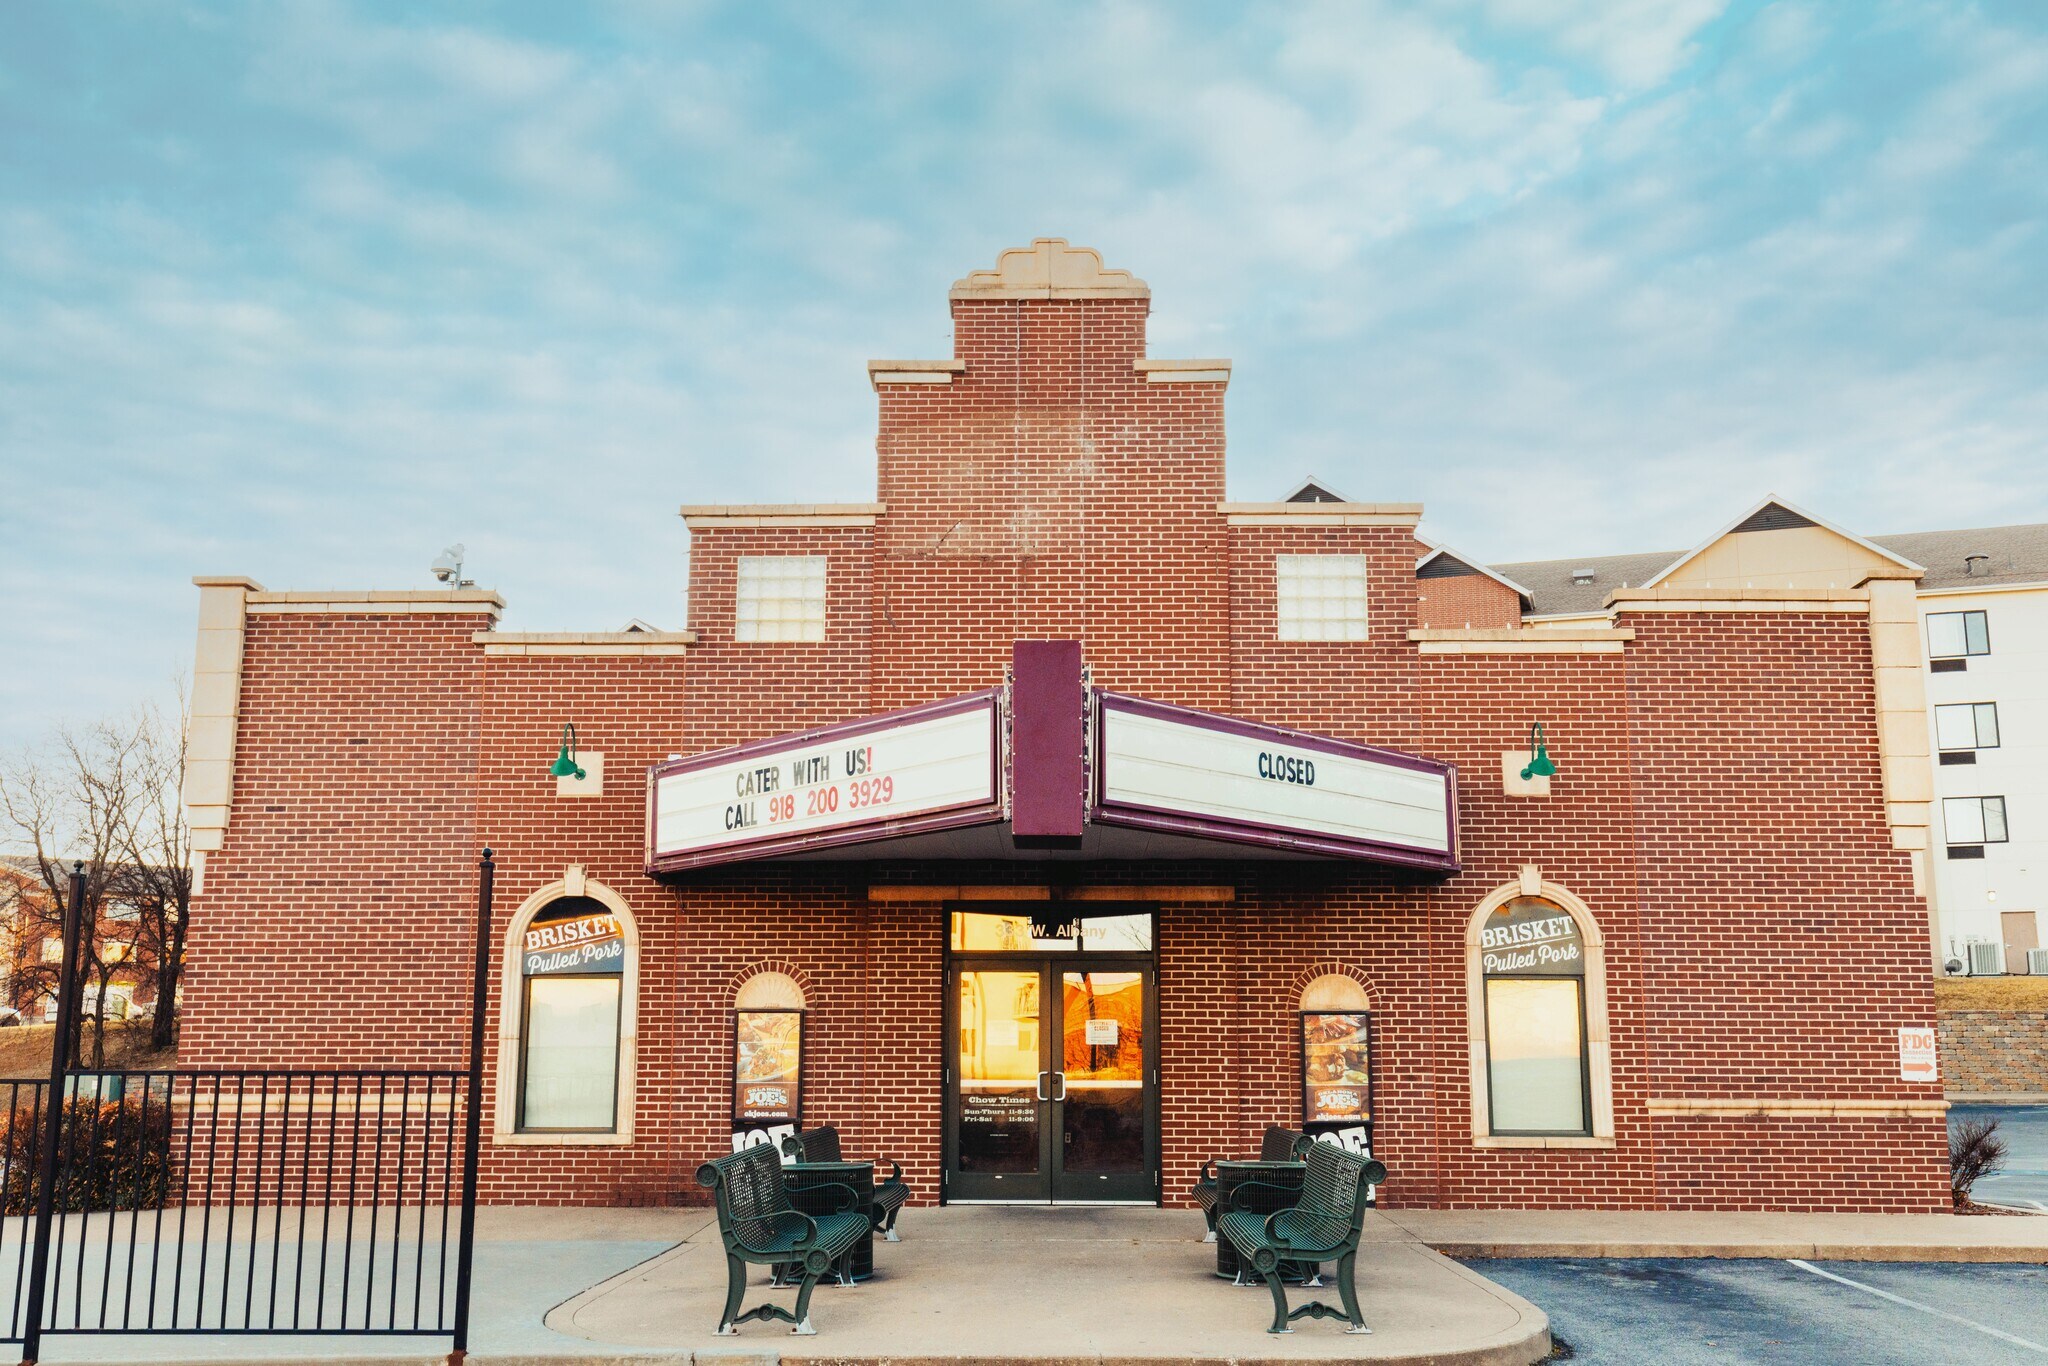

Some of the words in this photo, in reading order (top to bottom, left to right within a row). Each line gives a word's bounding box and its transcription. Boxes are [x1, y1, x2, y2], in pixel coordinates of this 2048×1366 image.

[736, 766, 780, 797] CATER
[793, 755, 830, 786] WITH
[846, 746, 872, 776] US!
[1258, 752, 1315, 786] CLOSED
[725, 801, 758, 830] CALL
[769, 794, 795, 822] 918
[807, 786, 839, 816] 200
[849, 775, 894, 809] 3929
[525, 914, 619, 950] BRISKET
[1031, 924, 1050, 937] W.
[1056, 924, 1107, 939] Albany
[1481, 915, 1573, 948] BRISKET
[528, 948, 581, 975] Pulled
[582, 940, 623, 963] Pork
[1483, 949, 1537, 974] Pulled
[1538, 943, 1580, 964] Pork
[1901, 1034, 1932, 1049] FDC
[744, 1110, 788, 1118] okjoes.com
[968, 1096, 998, 1104] Chow
[999, 1096, 1031, 1104] Times
